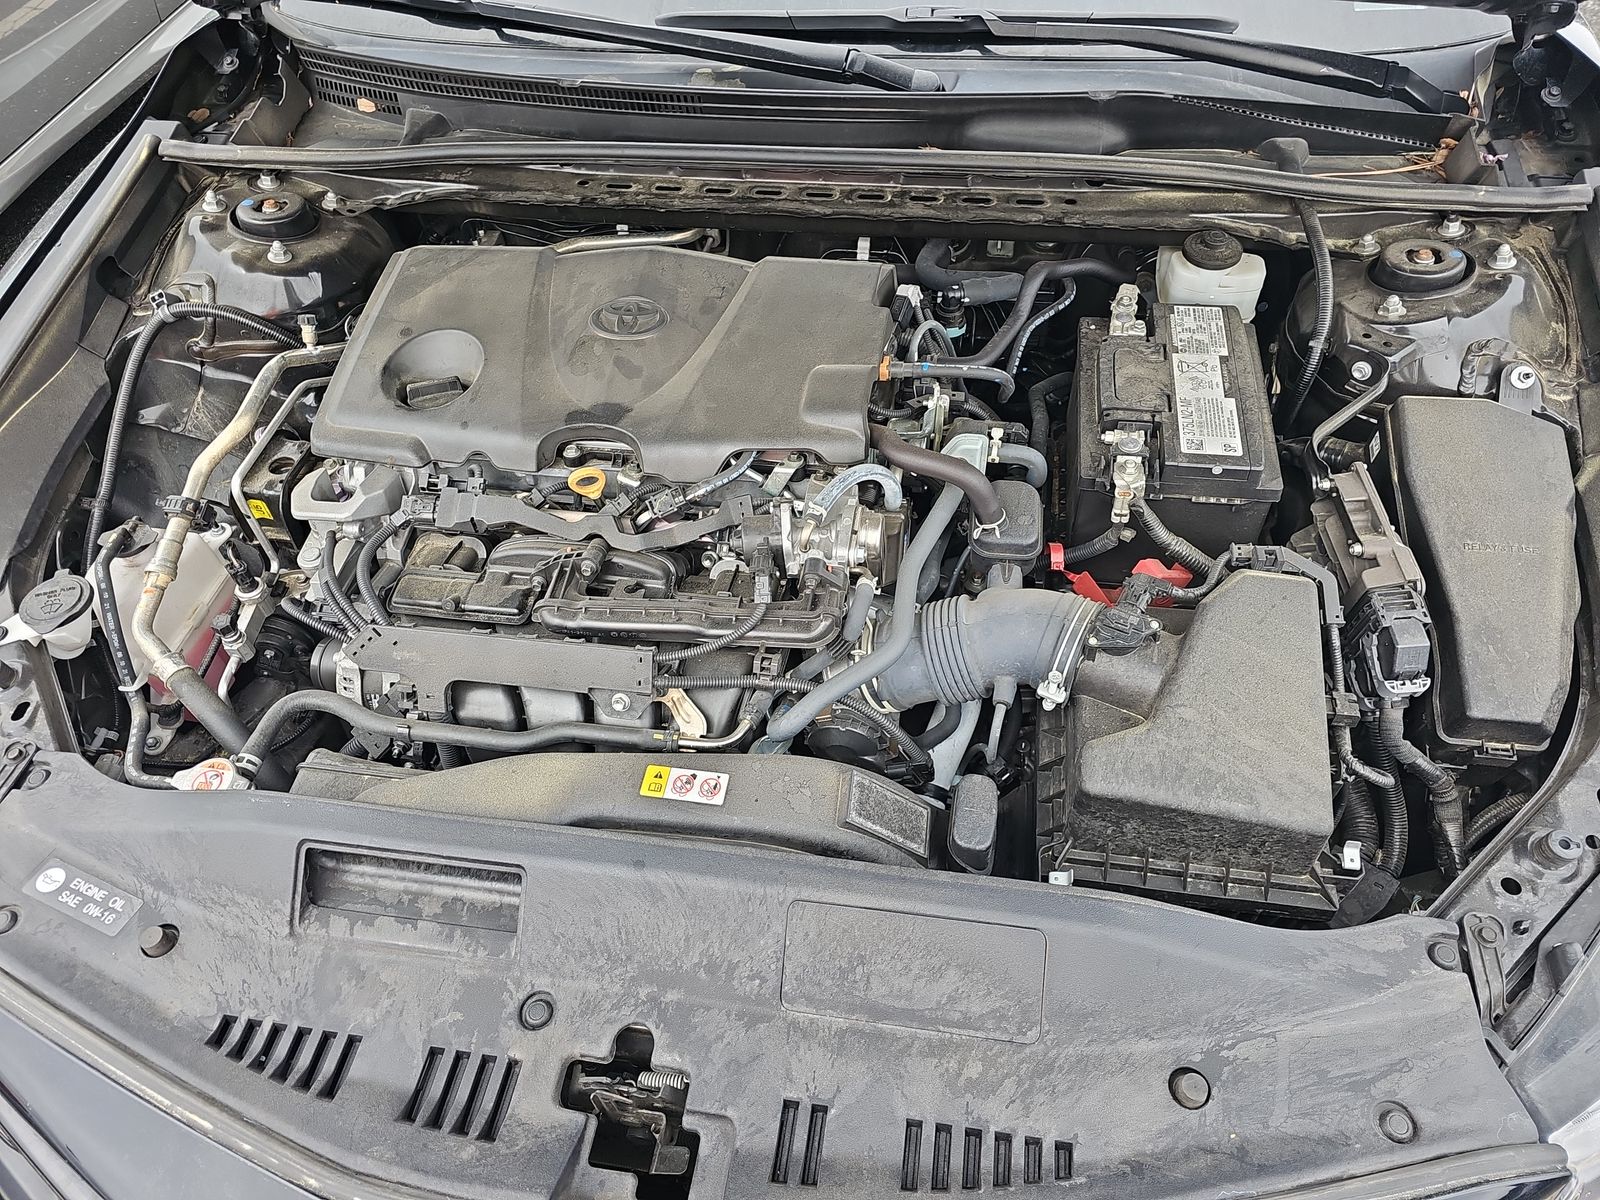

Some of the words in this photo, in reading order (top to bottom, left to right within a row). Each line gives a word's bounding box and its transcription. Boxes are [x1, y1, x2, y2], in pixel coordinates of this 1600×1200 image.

[1223, 443, 1237, 452] SP
[1463, 542, 1499, 552] RELAY
[1509, 544, 1539, 555] FUSE
[69, 878, 108, 902] ENGINE
[108, 896, 126, 912] OIL
[57, 890, 83, 909] SAE
[82, 902, 116, 925] 0W-16
